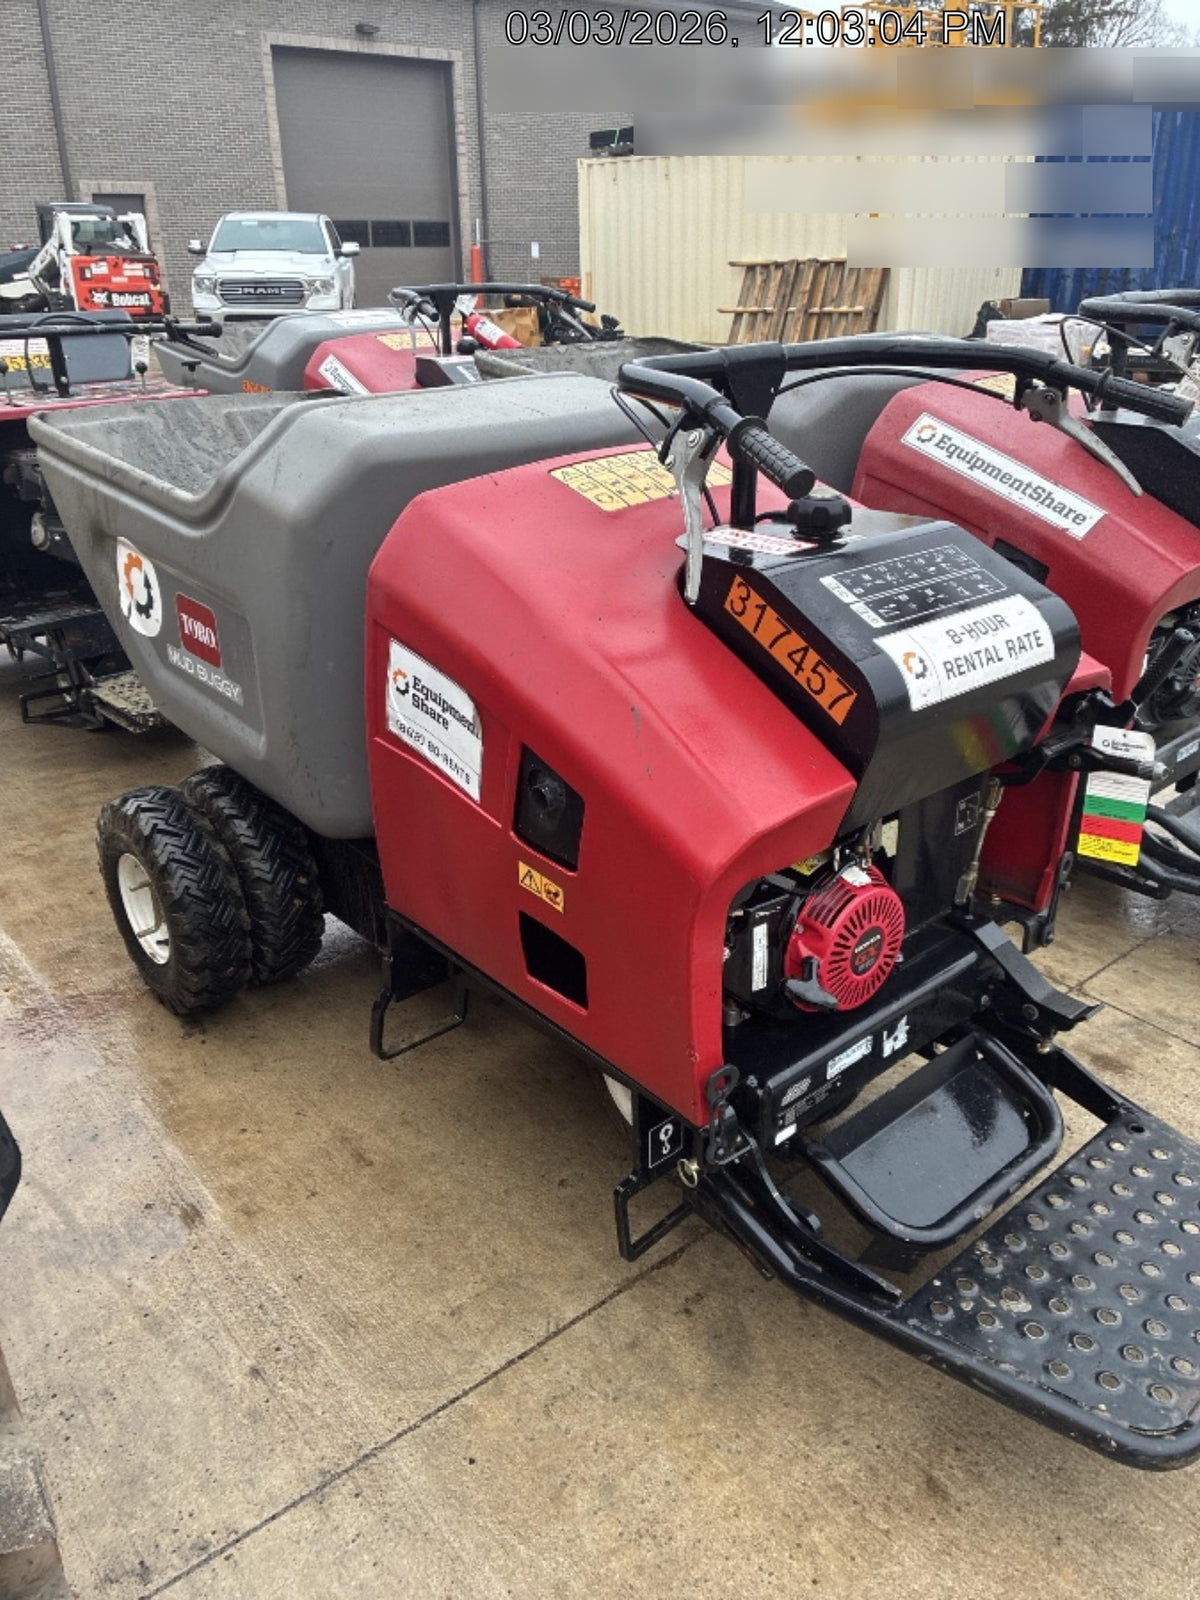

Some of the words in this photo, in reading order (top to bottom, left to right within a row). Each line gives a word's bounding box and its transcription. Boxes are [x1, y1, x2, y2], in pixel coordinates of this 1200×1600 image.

[111, 293, 150, 306] Bobcat
[934, 433, 1088, 526] EquipmentShare
[180, 613, 218, 648] TORO
[730, 581, 854, 710] 317457
[943, 645, 1003, 681] RENTAL
[1005, 629, 1045, 659] RATE
[945, 614, 1010, 645] 8-HOUR
[167, 644, 195, 674] MUD
[196, 664, 241, 703] BUGGY
[412, 675, 481, 739] Equipmen
[412, 693, 449, 731] Share
